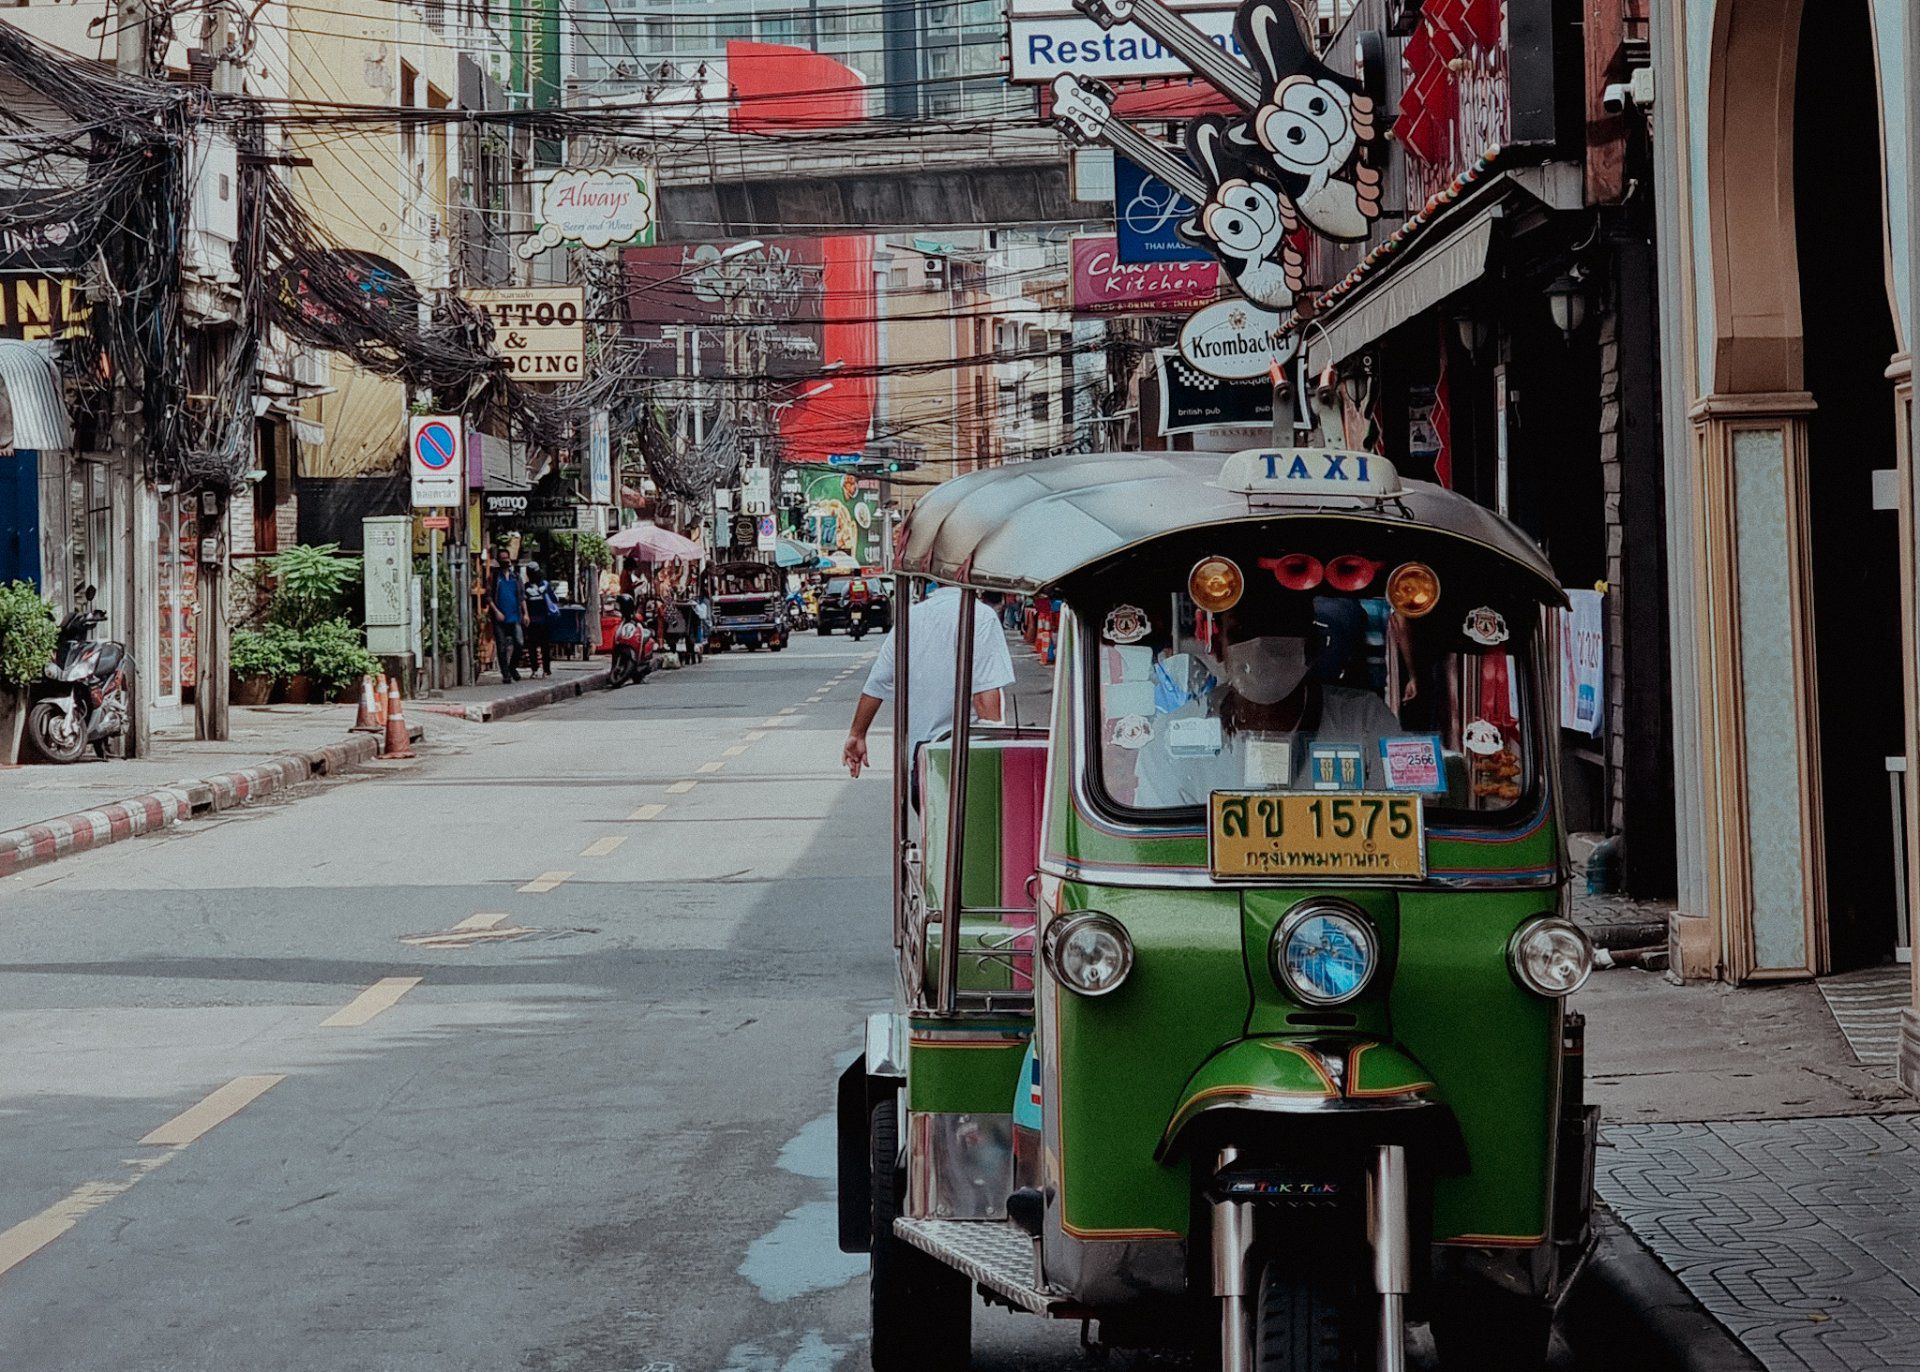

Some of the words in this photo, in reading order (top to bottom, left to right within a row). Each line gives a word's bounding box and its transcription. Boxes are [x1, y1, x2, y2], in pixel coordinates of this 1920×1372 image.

[1028, 31, 1244, 65] Restaunt
[557, 180, 630, 219] Always
[586, 220, 604, 231] and
[1145, 242, 1165, 250] THAI
[1104, 274, 1198, 293] Kitchen
[504, 331, 528, 349] &
[1191, 330, 1292, 359] Krombacher
[1178, 408, 1202, 417] british
[1205, 407, 1221, 417] pub
[1255, 405, 1270, 414] pub
[1258, 453, 1371, 482] TAXI
[1407, 754, 1434, 766] 2566
[1222, 795, 1284, 838] สข
[1309, 799, 1412, 840] 1575
